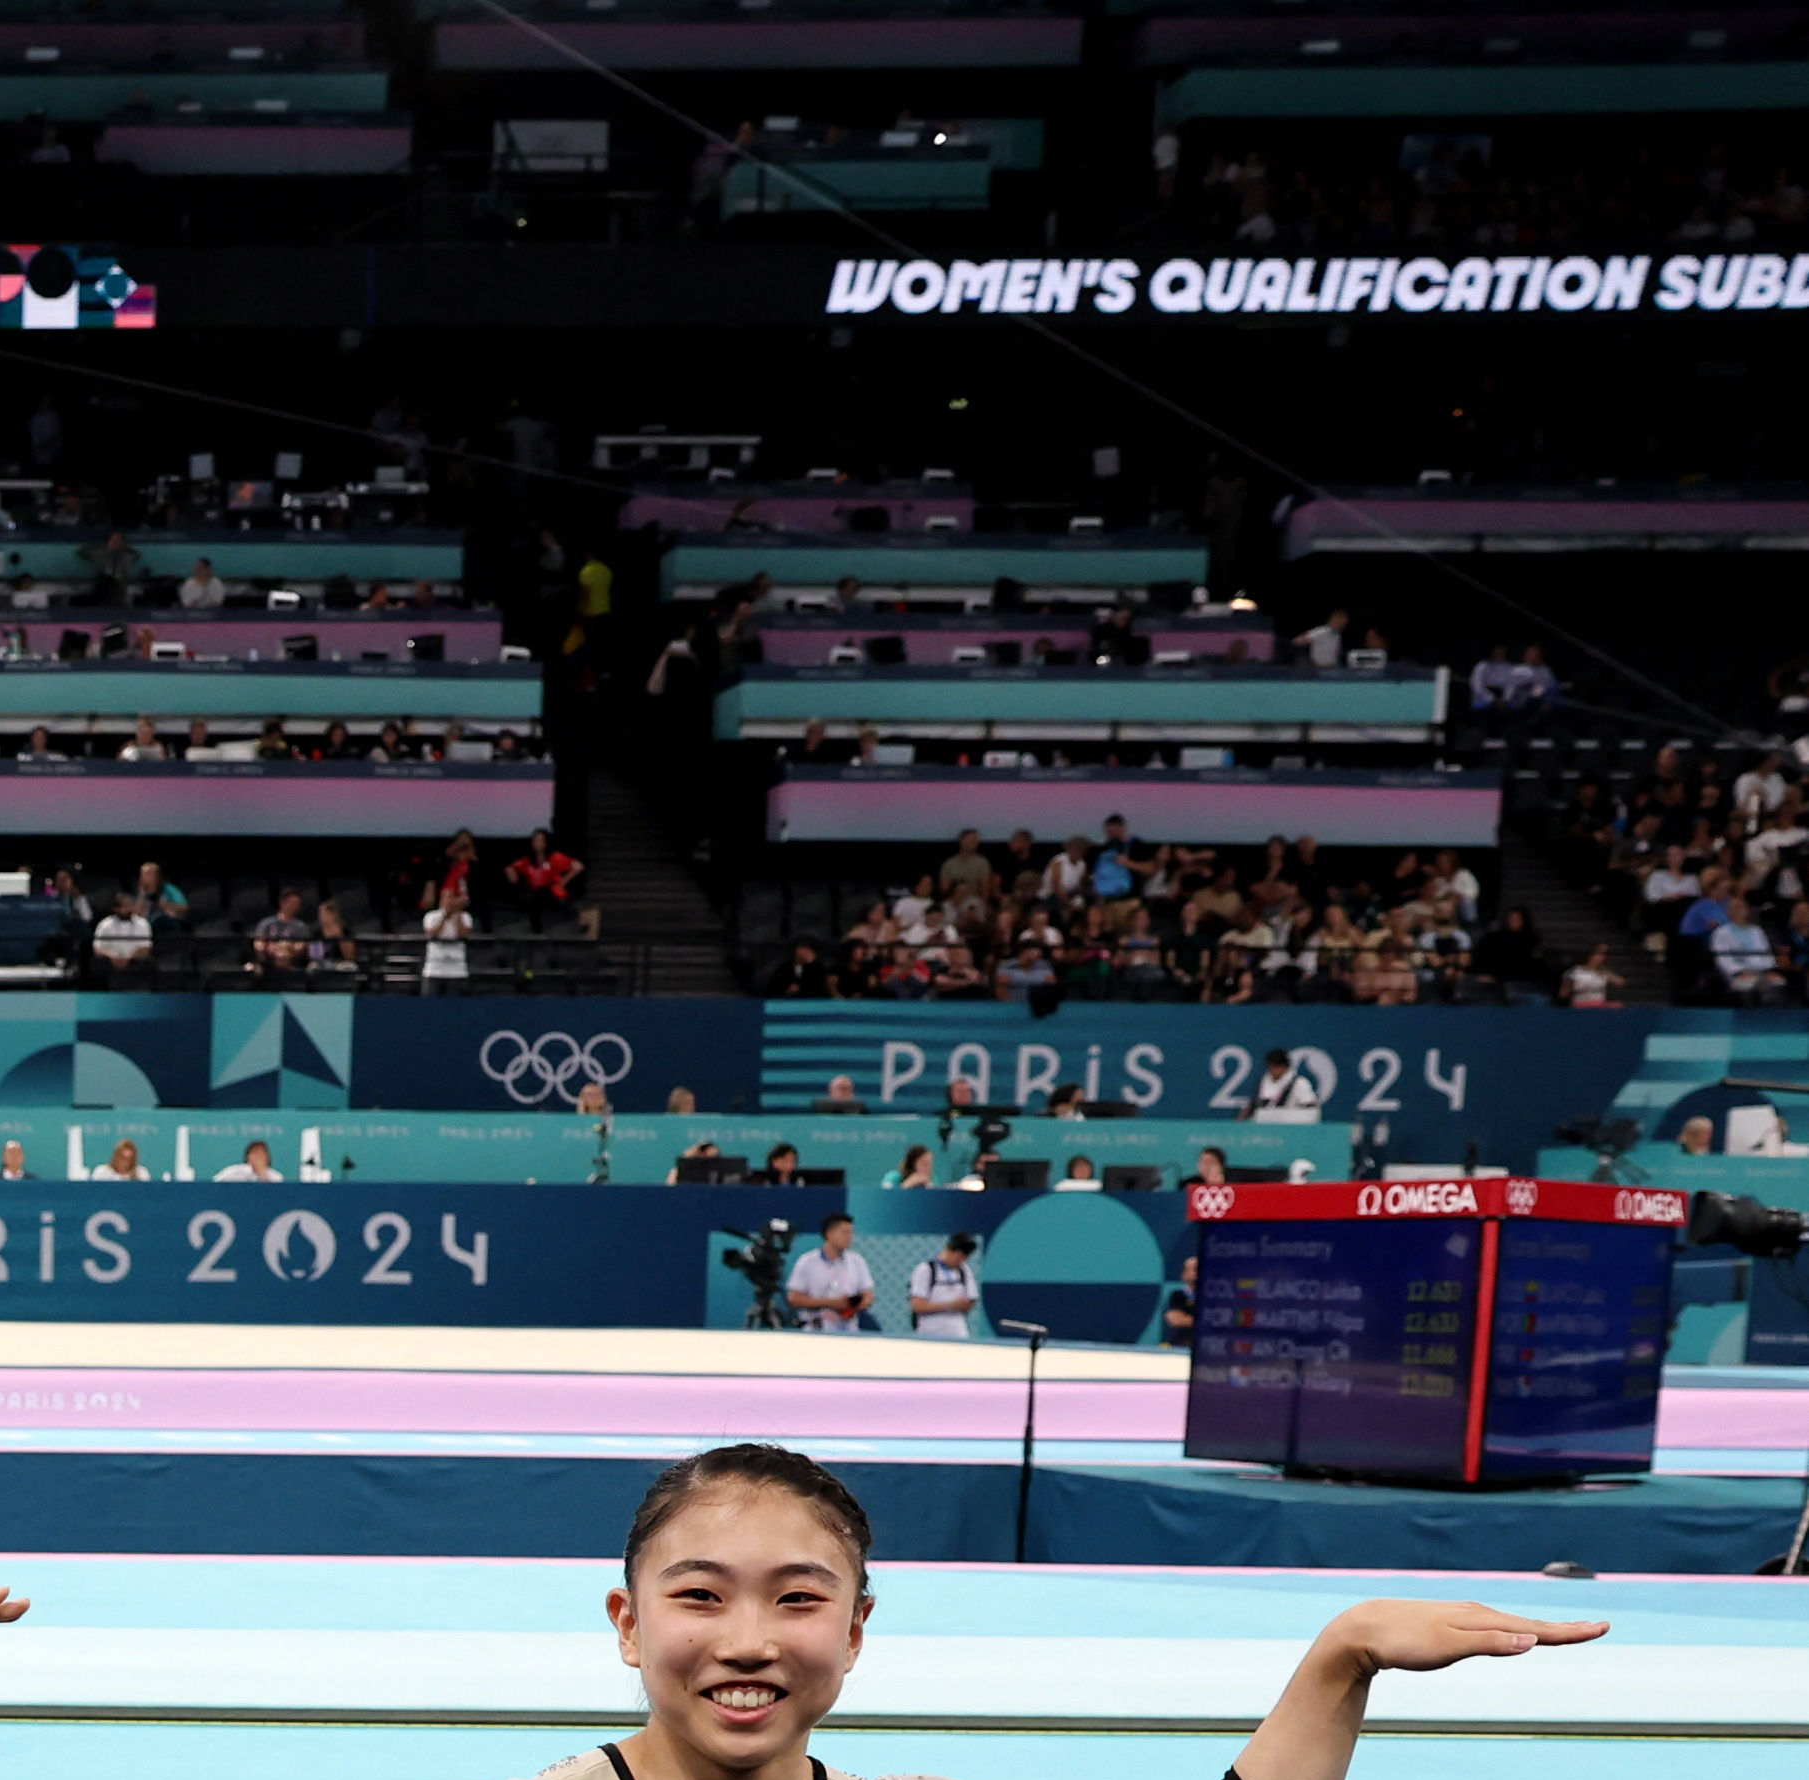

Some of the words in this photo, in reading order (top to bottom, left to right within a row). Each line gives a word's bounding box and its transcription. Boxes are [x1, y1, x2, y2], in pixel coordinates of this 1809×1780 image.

[826, 259, 1139, 313] WOMEN'S
[1150, 257, 1650, 312] QUALIFICATION
[883, 1041, 1163, 1106] PARIS
[1209, 1046, 1466, 1110] 2024
[1385, 1183, 1479, 1215] OMEGA
[187, 1209, 488, 1285] 2024
[74, 1392, 143, 1412] 2024
